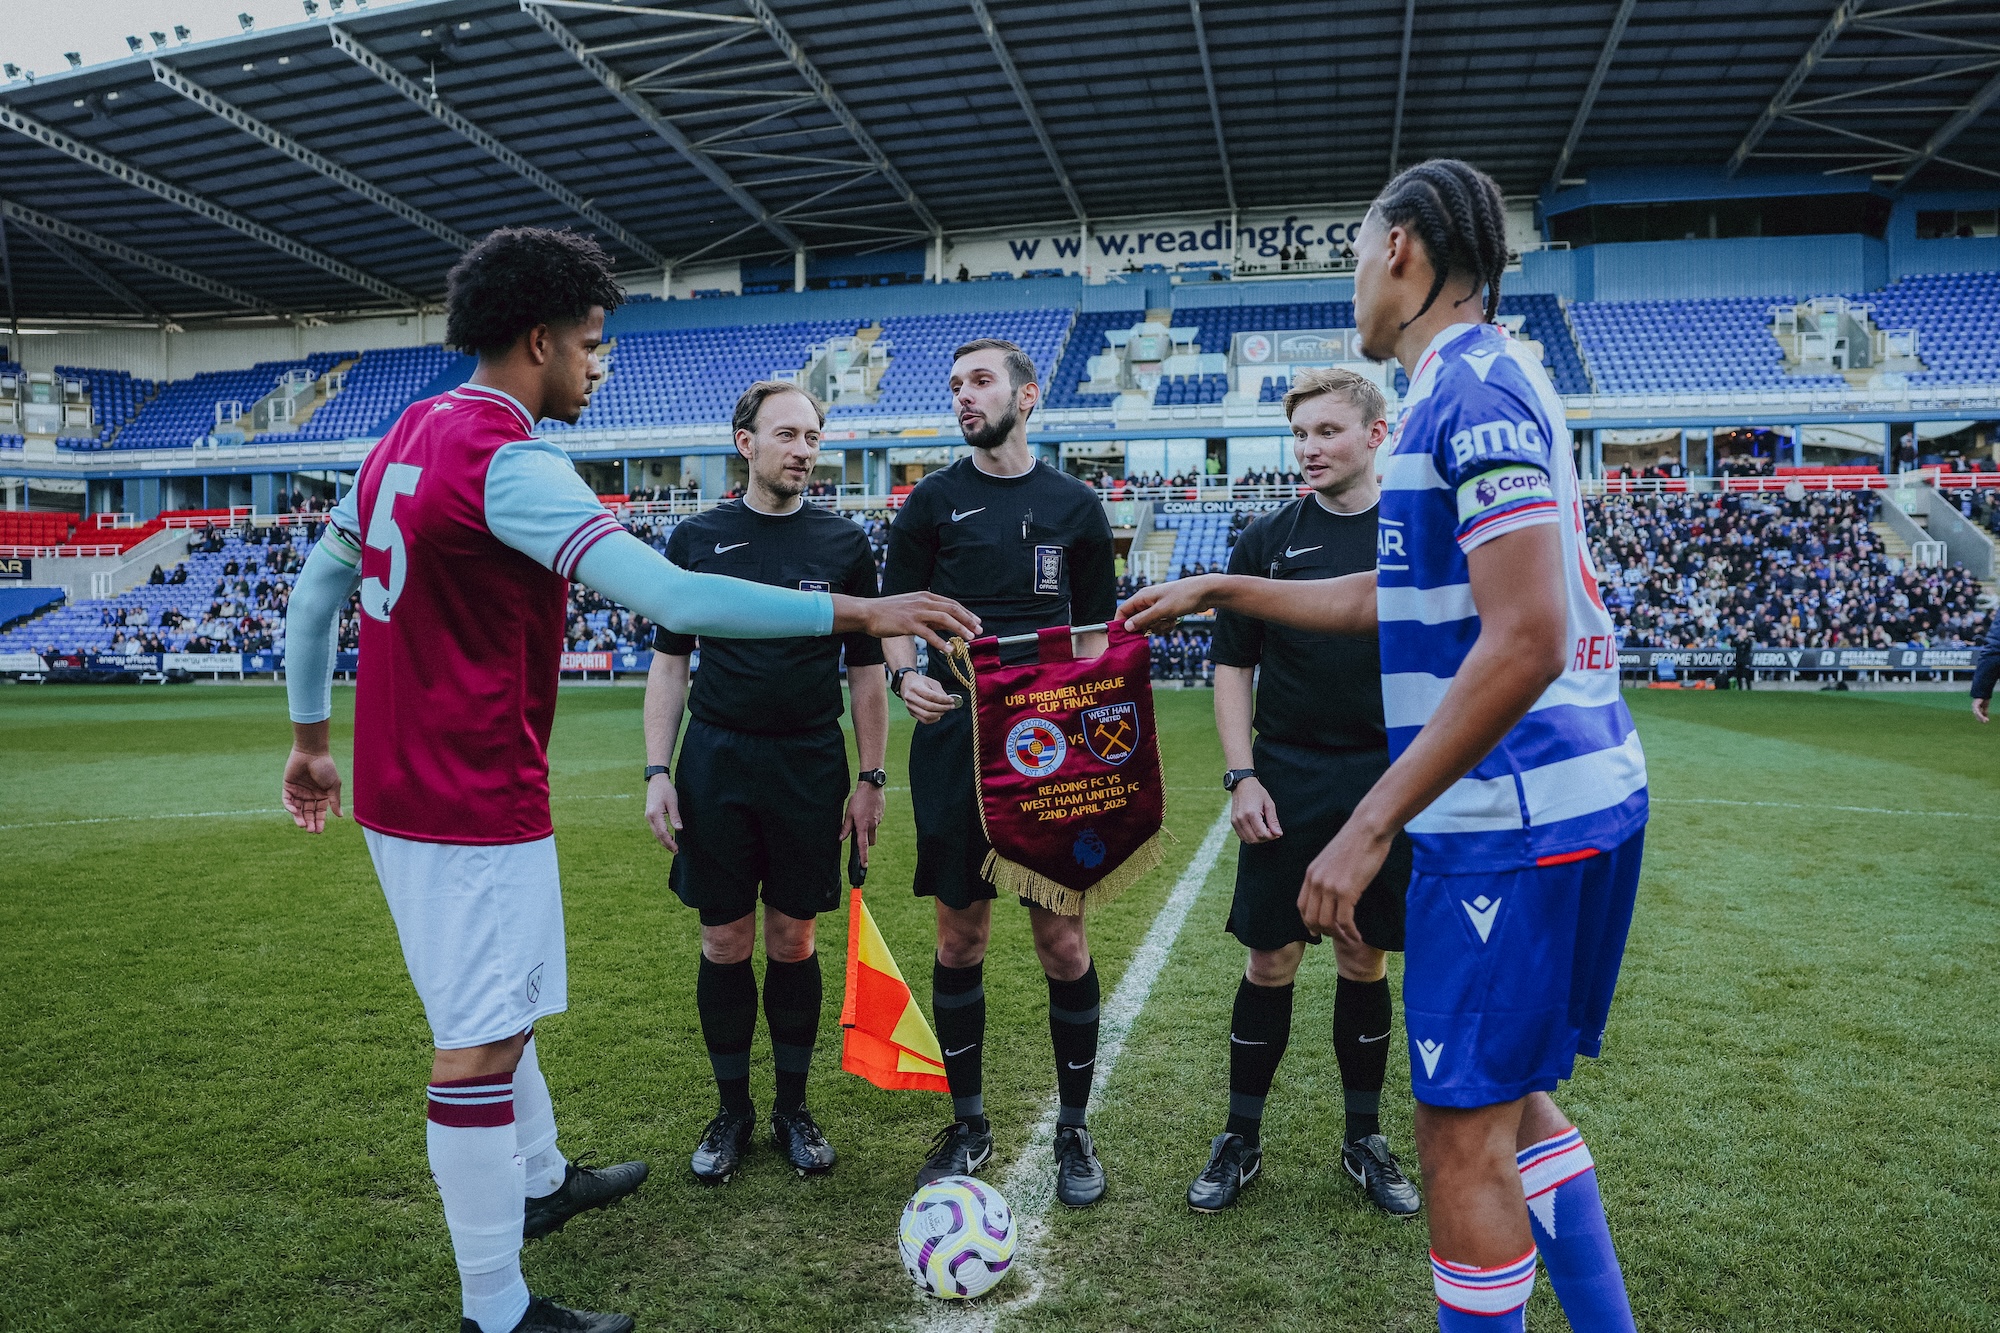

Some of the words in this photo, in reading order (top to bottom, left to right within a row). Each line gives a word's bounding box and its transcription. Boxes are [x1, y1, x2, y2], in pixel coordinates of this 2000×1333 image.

[1450, 419, 1542, 467] BMG
[1163, 502, 1202, 513] COME
[1203, 502, 1224, 513] ON
[361, 462, 423, 622] 5
[1692, 653, 1724, 666] YOUR
[1005, 694, 1026, 706] U18
[1029, 686, 1077, 703] PREMIER
[1080, 677, 1125, 695] LEAGUE
[1037, 701, 1060, 713] CUP
[1063, 695, 1097, 709] FINAL
[1088, 709, 1110, 720] WEST
[1112, 706, 1130, 714] HAM
[1099, 714, 1121, 723] UNITED
[1008, 726, 1021, 760] READING
[1020, 719, 1055, 732] FOOTBALL
[1055, 732, 1065, 751] CLUB
[1068, 733, 1084, 745] VS
[1106, 751, 1127, 760] LONDON
[1038, 780, 1087, 796] READING
[1091, 777, 1105, 788] FC
[1107, 774, 1121, 785] VS
[1020, 798, 1052, 812] WEST
[1055, 794, 1083, 807] HAM
[1086, 786, 1124, 801] UNITED
[1127, 782, 1140, 793] FC
[1038, 809, 1067, 821] 22ND
[1070, 804, 1101, 817] APRIL
[1103, 797, 1127, 811] 2025
